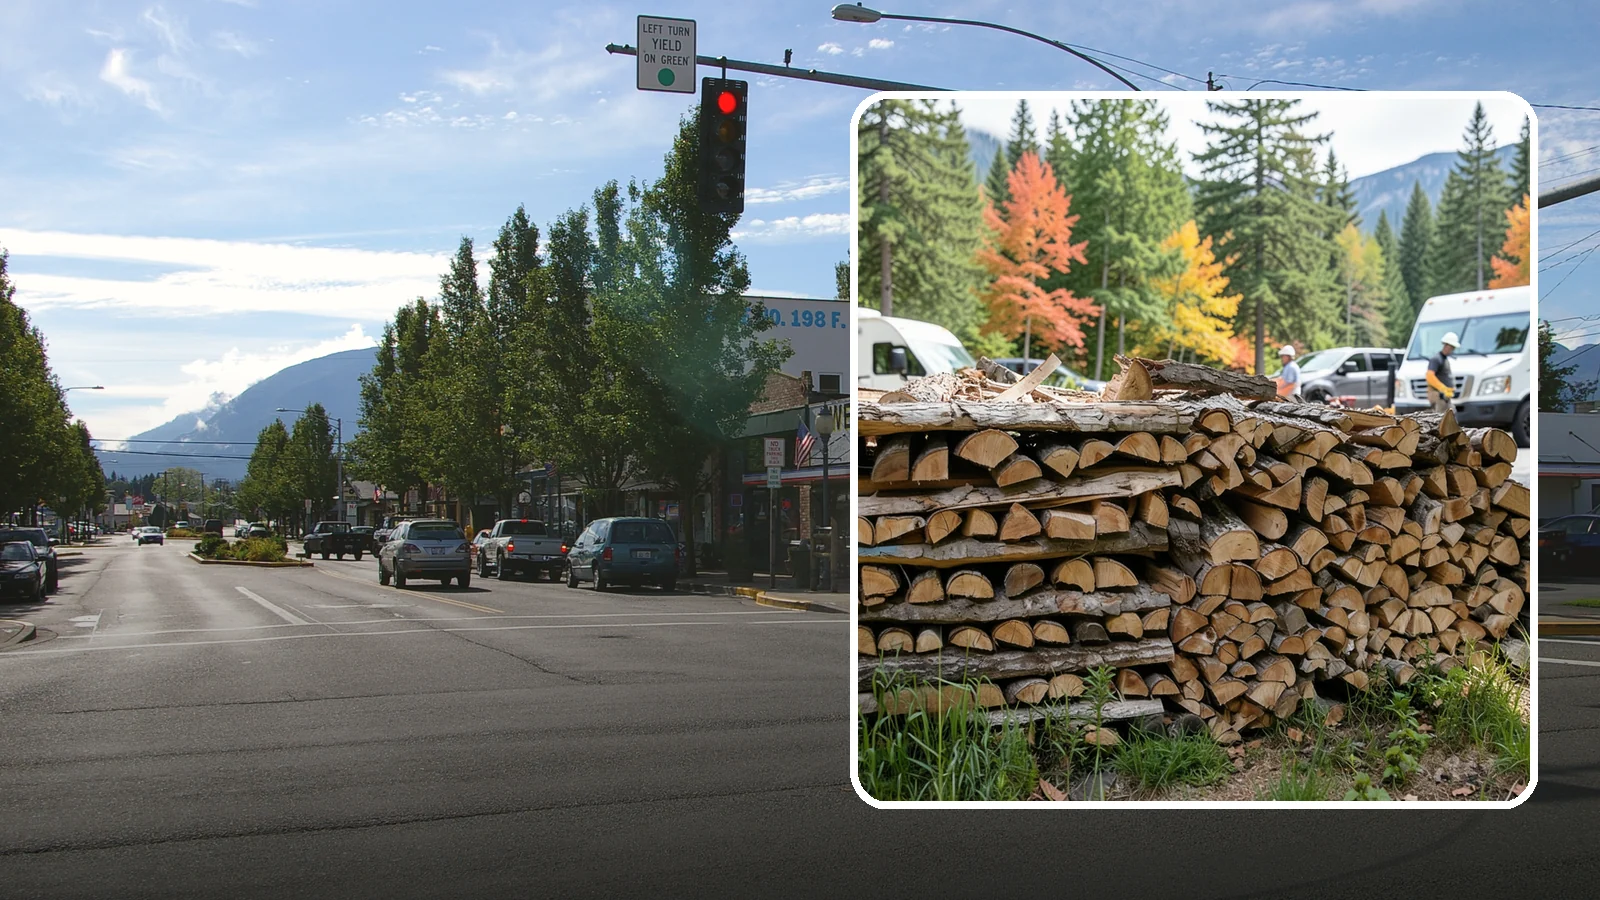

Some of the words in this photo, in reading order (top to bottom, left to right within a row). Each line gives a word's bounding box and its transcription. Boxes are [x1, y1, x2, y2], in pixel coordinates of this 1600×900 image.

[643, 24, 663, 34] LEFT
[668, 26, 690, 36] TURN
[652, 38, 682, 52] YIELD
[644, 54, 656, 63] ON
[661, 55, 688, 66] GREEN
[791, 309, 827, 328] 198
[831, 311, 847, 329] F.
